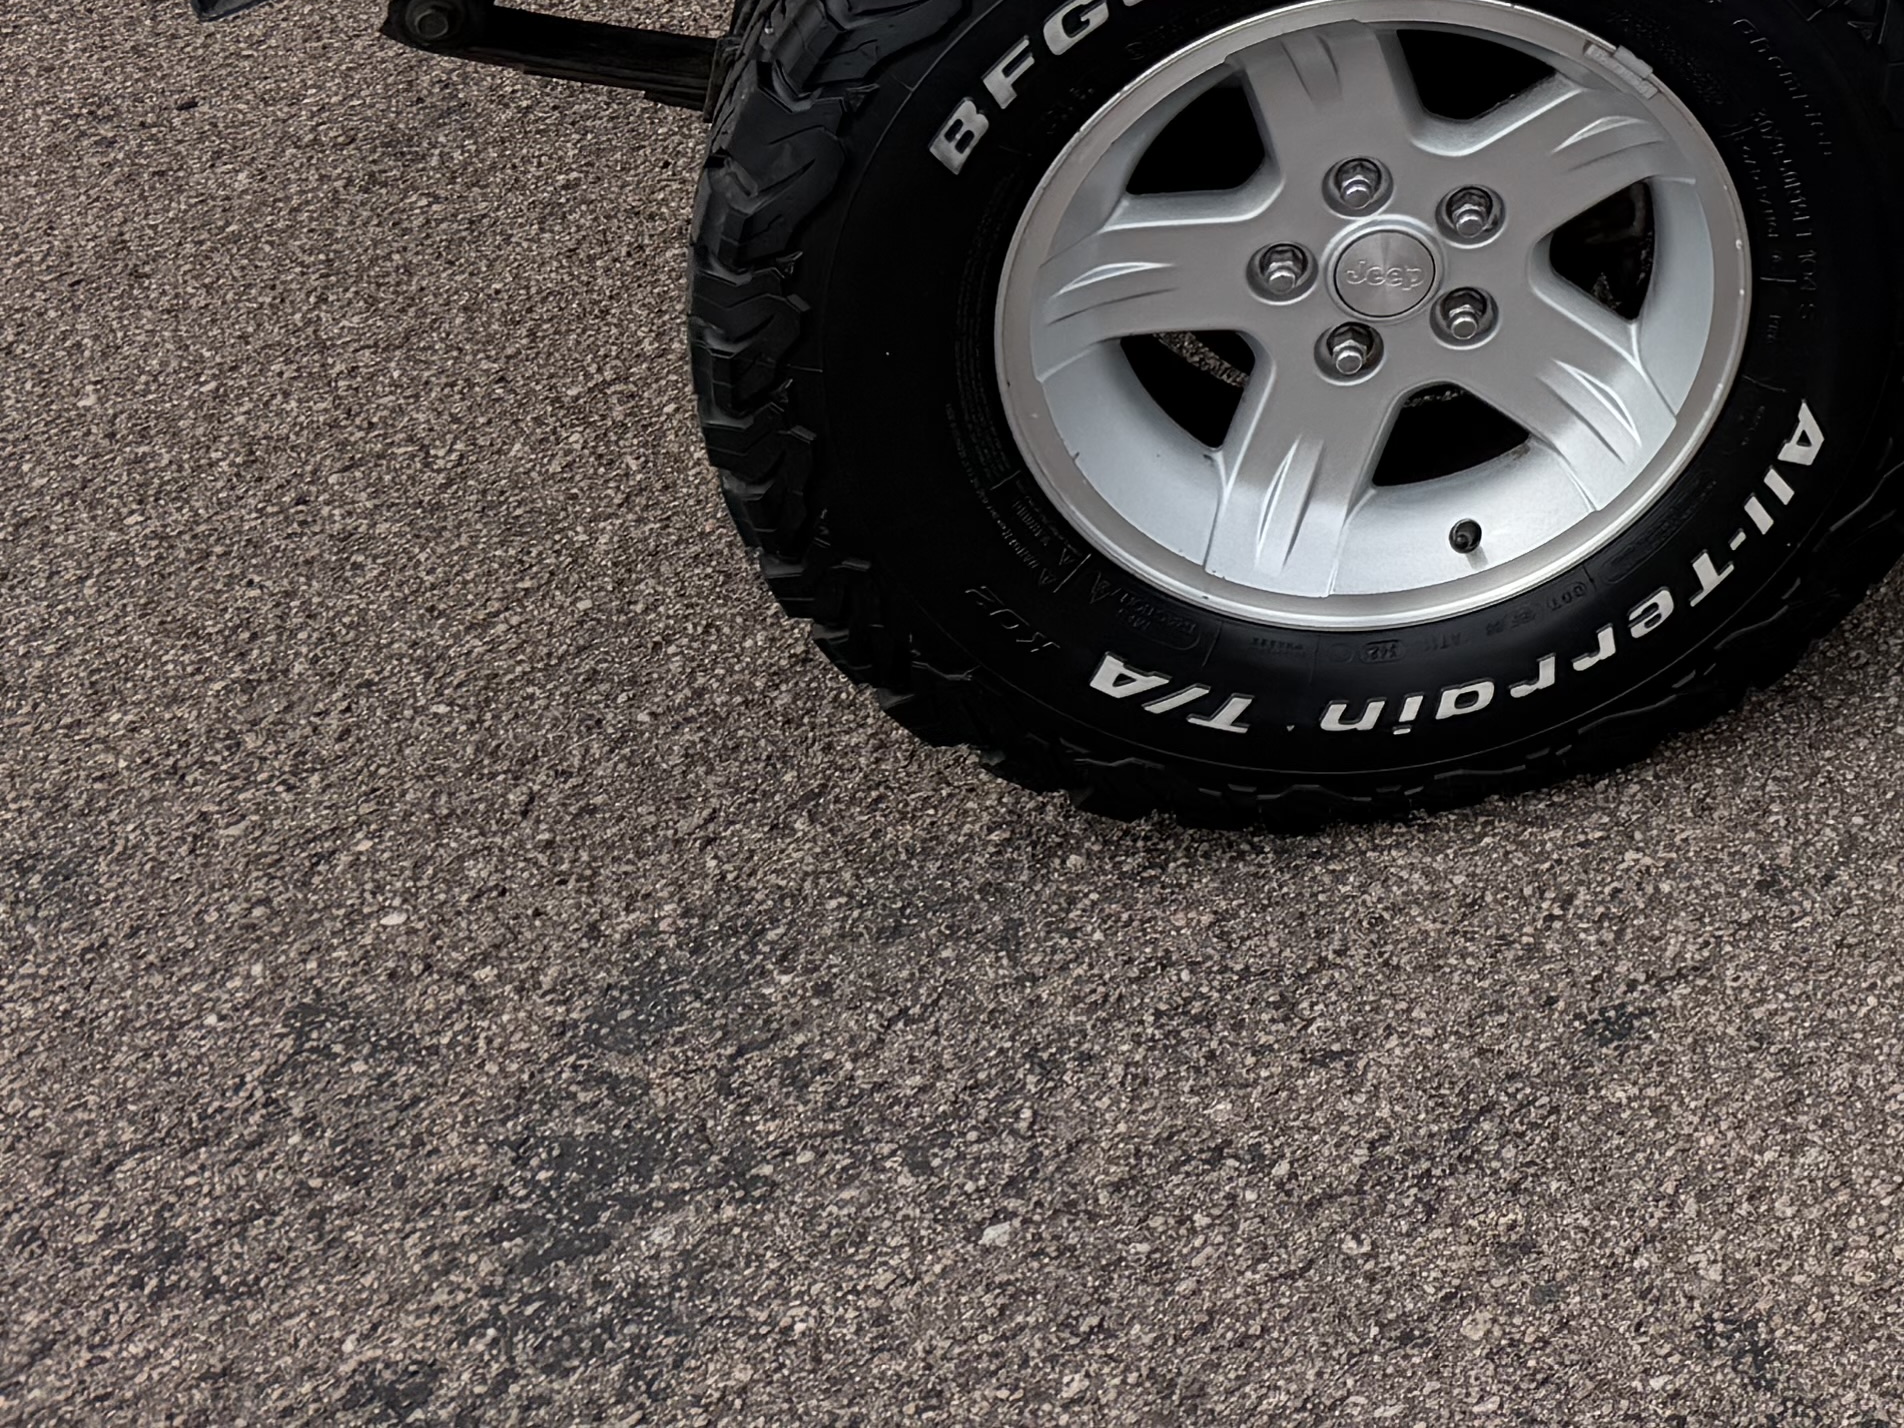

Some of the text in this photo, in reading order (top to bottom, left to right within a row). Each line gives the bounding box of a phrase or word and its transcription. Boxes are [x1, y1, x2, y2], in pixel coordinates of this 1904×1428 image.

[1346, 259, 1425, 291] Jeep
[1319, 400, 1826, 734] All-Terrain
[1087, 652, 1253, 734] T/A
